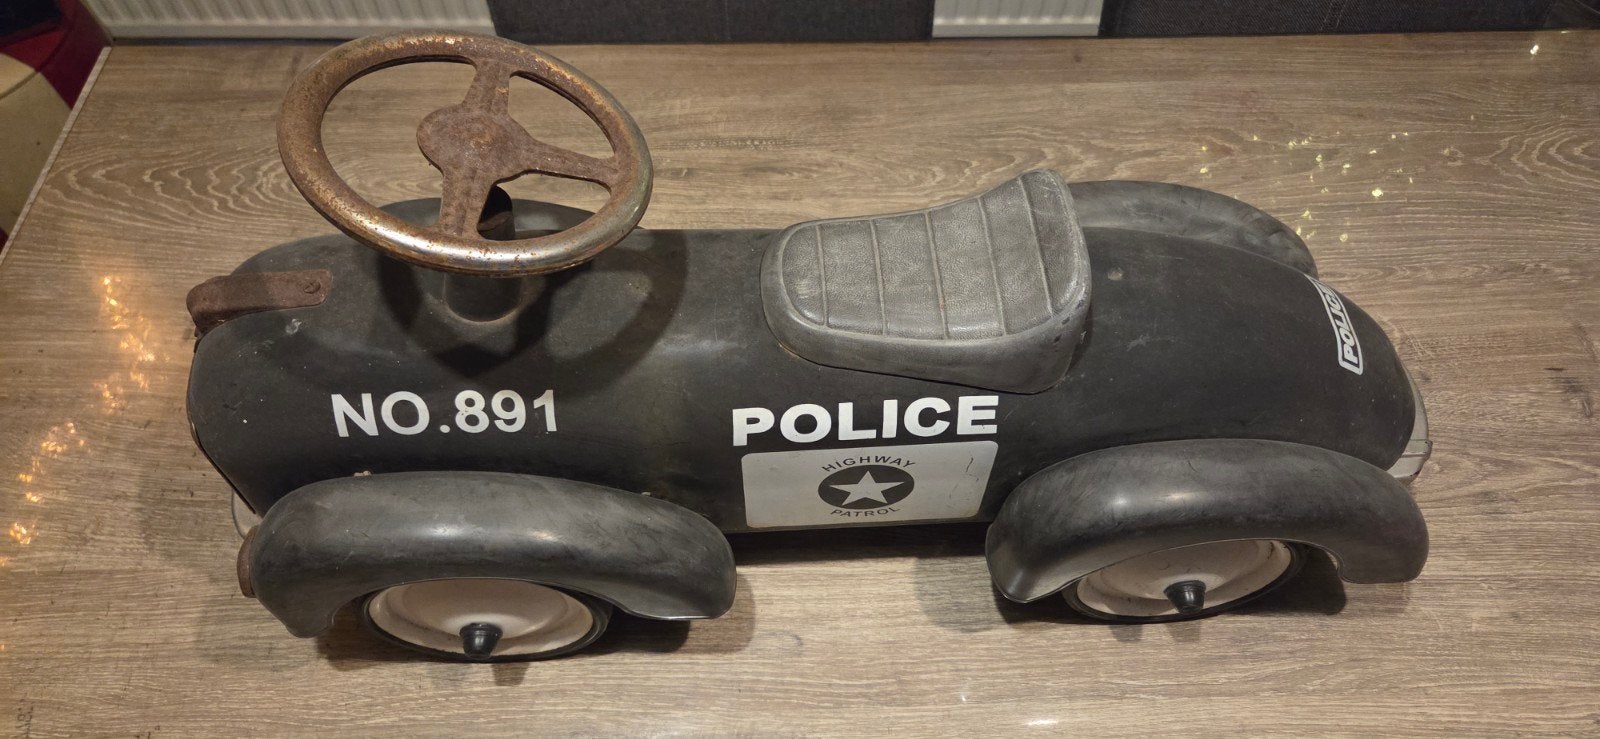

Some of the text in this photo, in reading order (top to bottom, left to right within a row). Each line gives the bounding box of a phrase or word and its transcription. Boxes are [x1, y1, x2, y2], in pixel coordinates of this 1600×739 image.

[732, 395, 999, 446] POLICE
[822, 455, 916, 473] HIGHWAY
[830, 506, 901, 518] PATROL
